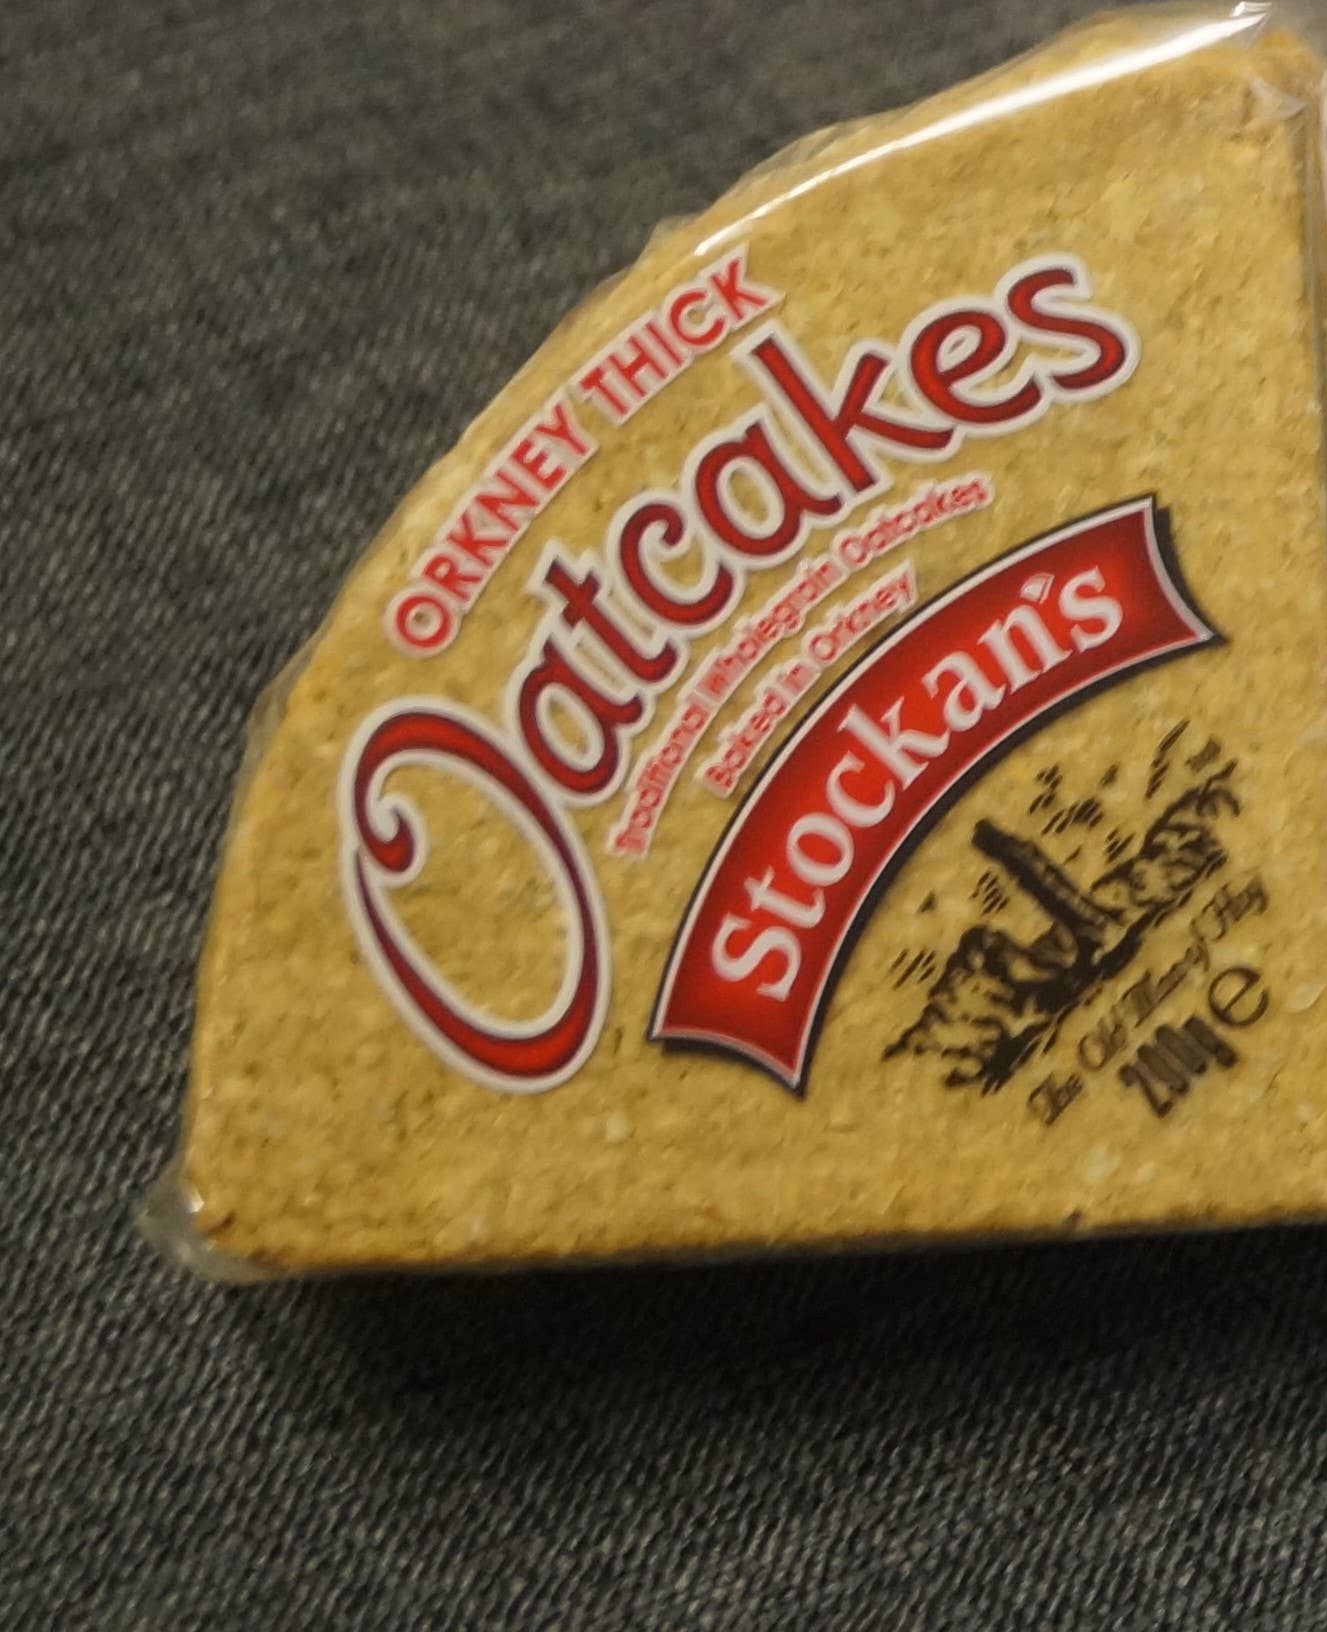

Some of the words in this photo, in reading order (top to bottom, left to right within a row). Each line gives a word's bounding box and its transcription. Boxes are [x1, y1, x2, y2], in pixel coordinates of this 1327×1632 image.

[390, 400, 594, 652] ORKNEY
[581, 254, 776, 416] THICK
[348, 260, 1132, 1086] Oatcakes
[611, 696, 712, 856] Traditional
[696, 558, 841, 700] Wholegrain
[836, 475, 993, 567] Oatcakes
[700, 688, 788, 794] Baked
[779, 660, 818, 698] in
[807, 564, 916, 664] Orkney
[710, 561, 1126, 1002] Stockan's
[1117, 1011, 1239, 1119] 200g
